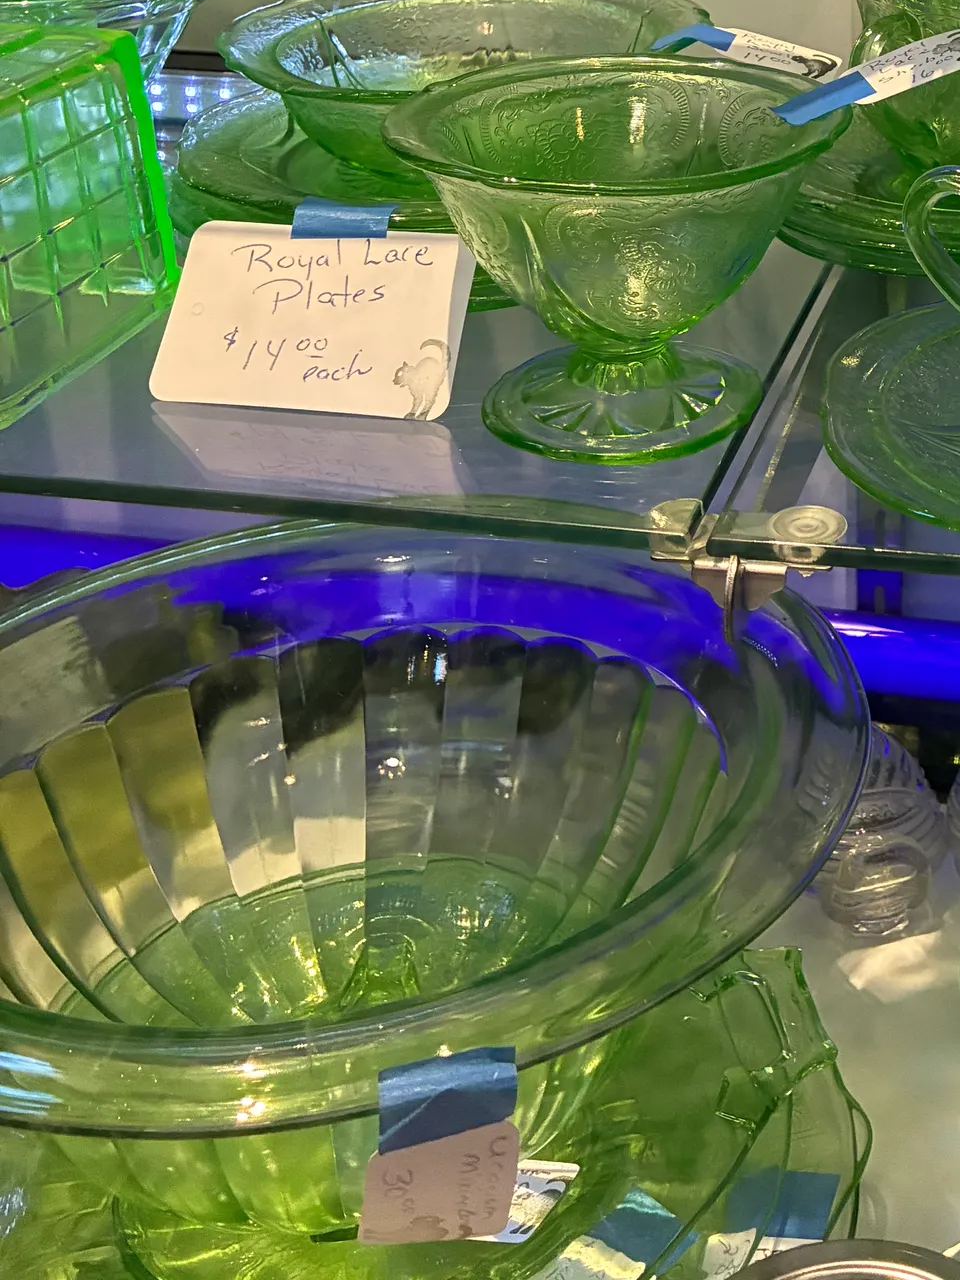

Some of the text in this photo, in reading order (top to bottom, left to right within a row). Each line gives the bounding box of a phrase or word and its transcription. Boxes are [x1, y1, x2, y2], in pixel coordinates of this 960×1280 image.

[230, 238, 434, 281] Royal Lace
[252, 274, 386, 315] Plates
[302, 349, 373, 383] each
